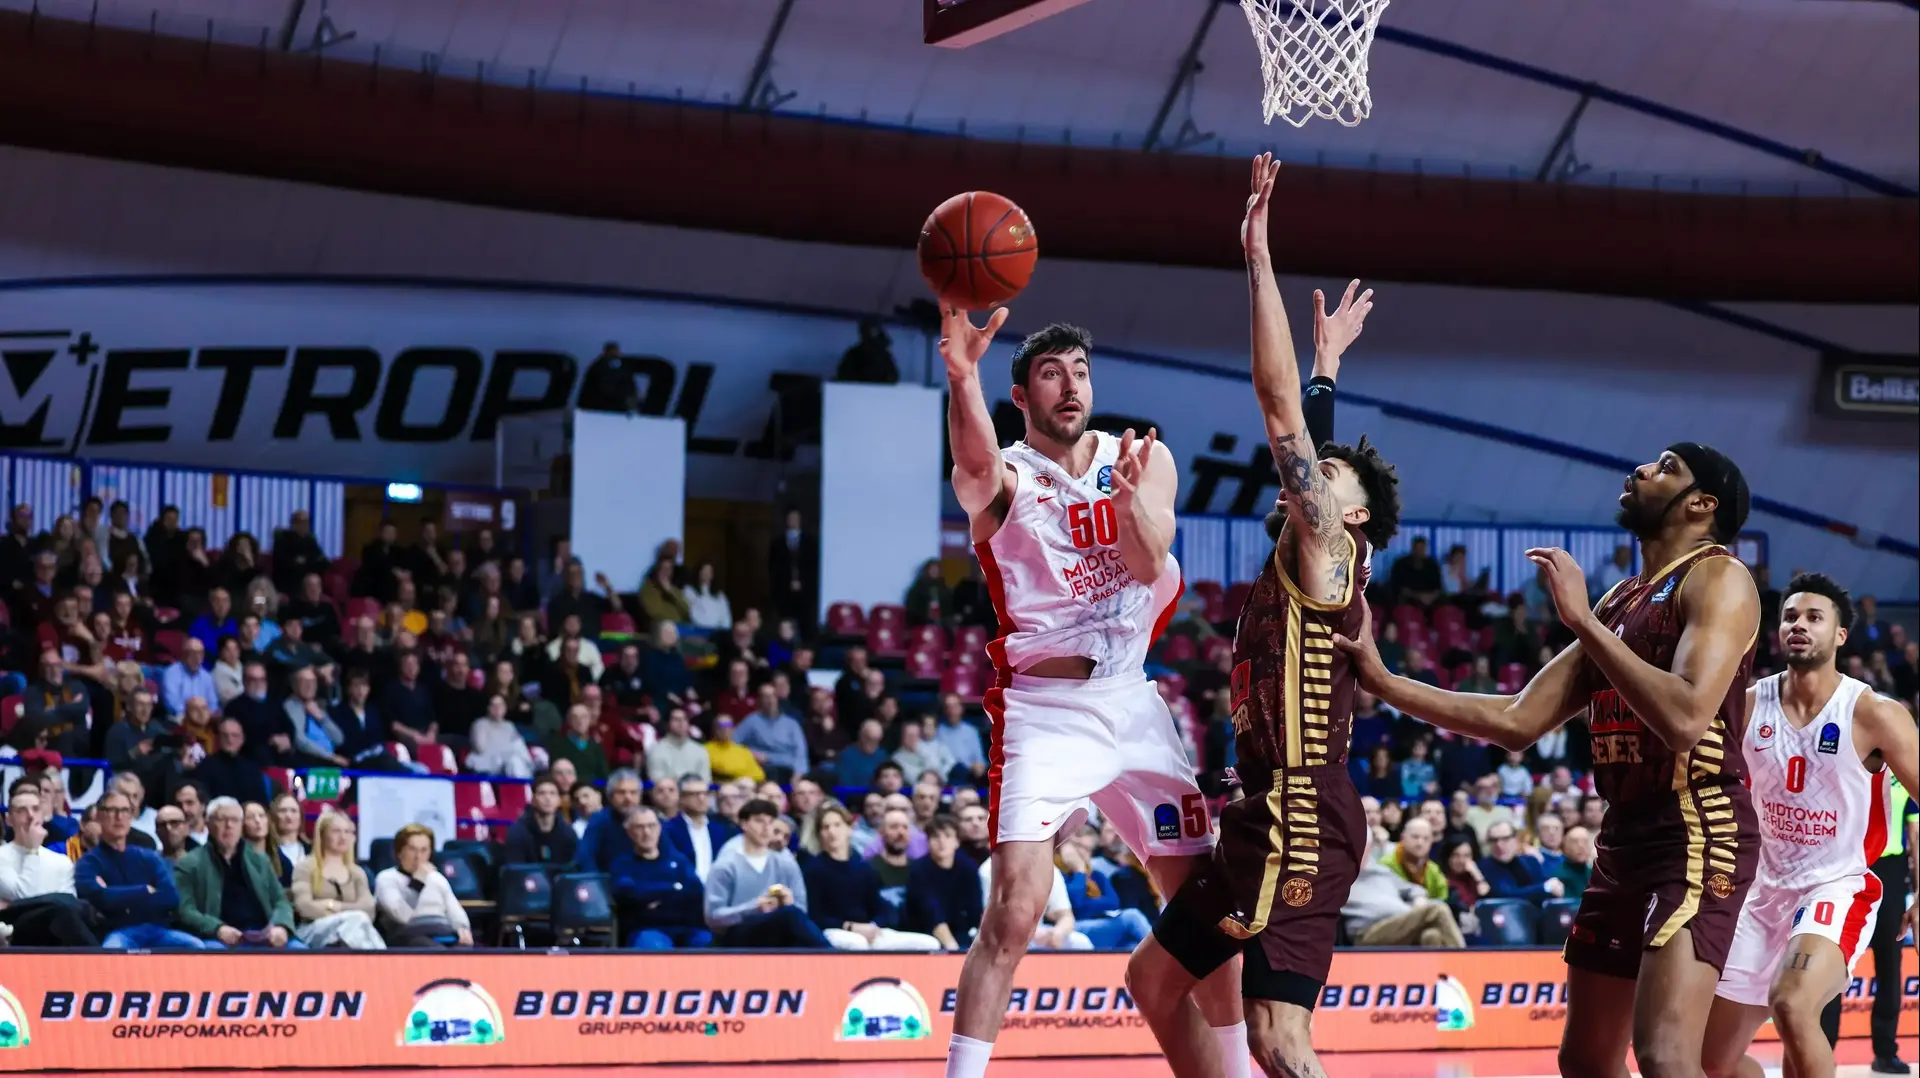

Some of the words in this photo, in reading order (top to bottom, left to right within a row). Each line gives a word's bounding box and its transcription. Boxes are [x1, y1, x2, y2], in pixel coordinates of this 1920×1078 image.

[1067, 498, 1118, 549] 50
[1062, 550, 1122, 582] MIDTO
[1786, 756, 1806, 793] 0
[1181, 793, 1214, 838] 5
[1761, 798, 1838, 823] MIDTOWN
[1762, 812, 1837, 837] JERUSALEM
[1814, 901, 1835, 926] 0
[40, 991, 364, 1019] BORDIGNON
[513, 989, 805, 1017] BORDIGNON
[112, 1022, 297, 1039] GRUPPOMARCATO
[578, 1020, 745, 1035] GRUPPOMARCATO
